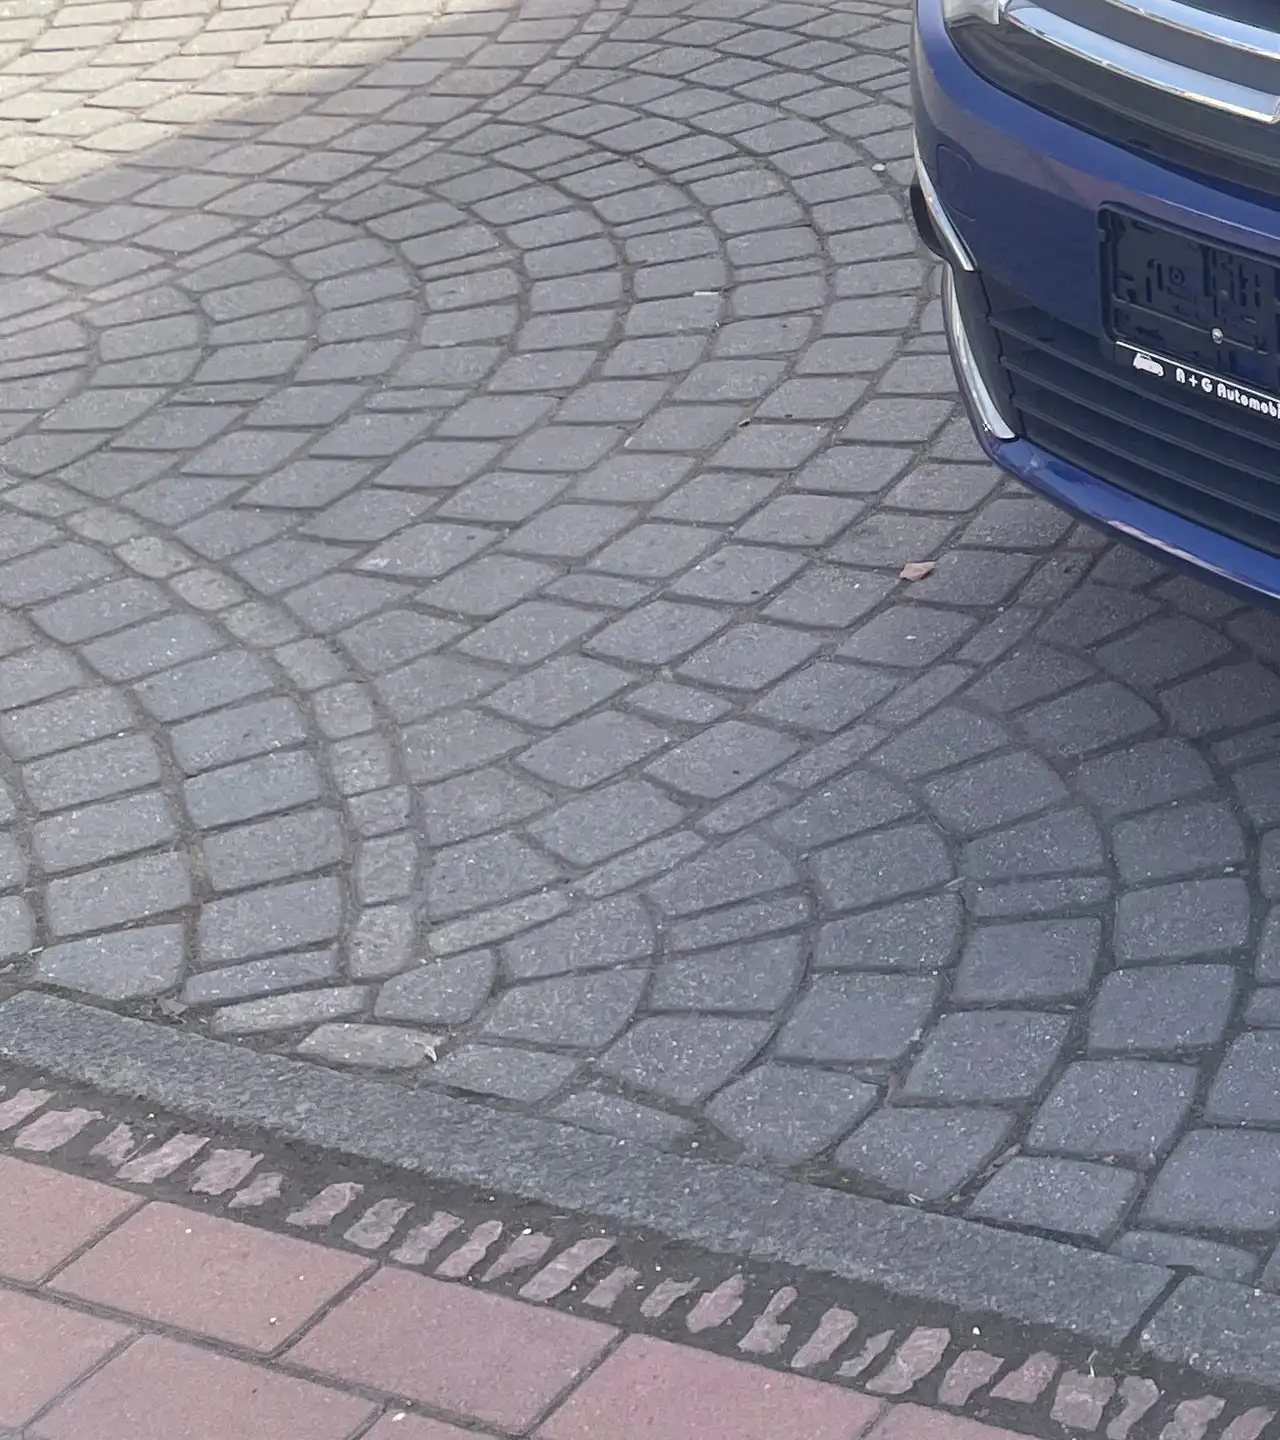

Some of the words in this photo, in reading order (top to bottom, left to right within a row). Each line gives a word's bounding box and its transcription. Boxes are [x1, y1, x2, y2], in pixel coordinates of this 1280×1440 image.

[1175, 368, 1186, 384] A
[1188, 374, 1198, 388] +
[1201, 377, 1213, 393] G
